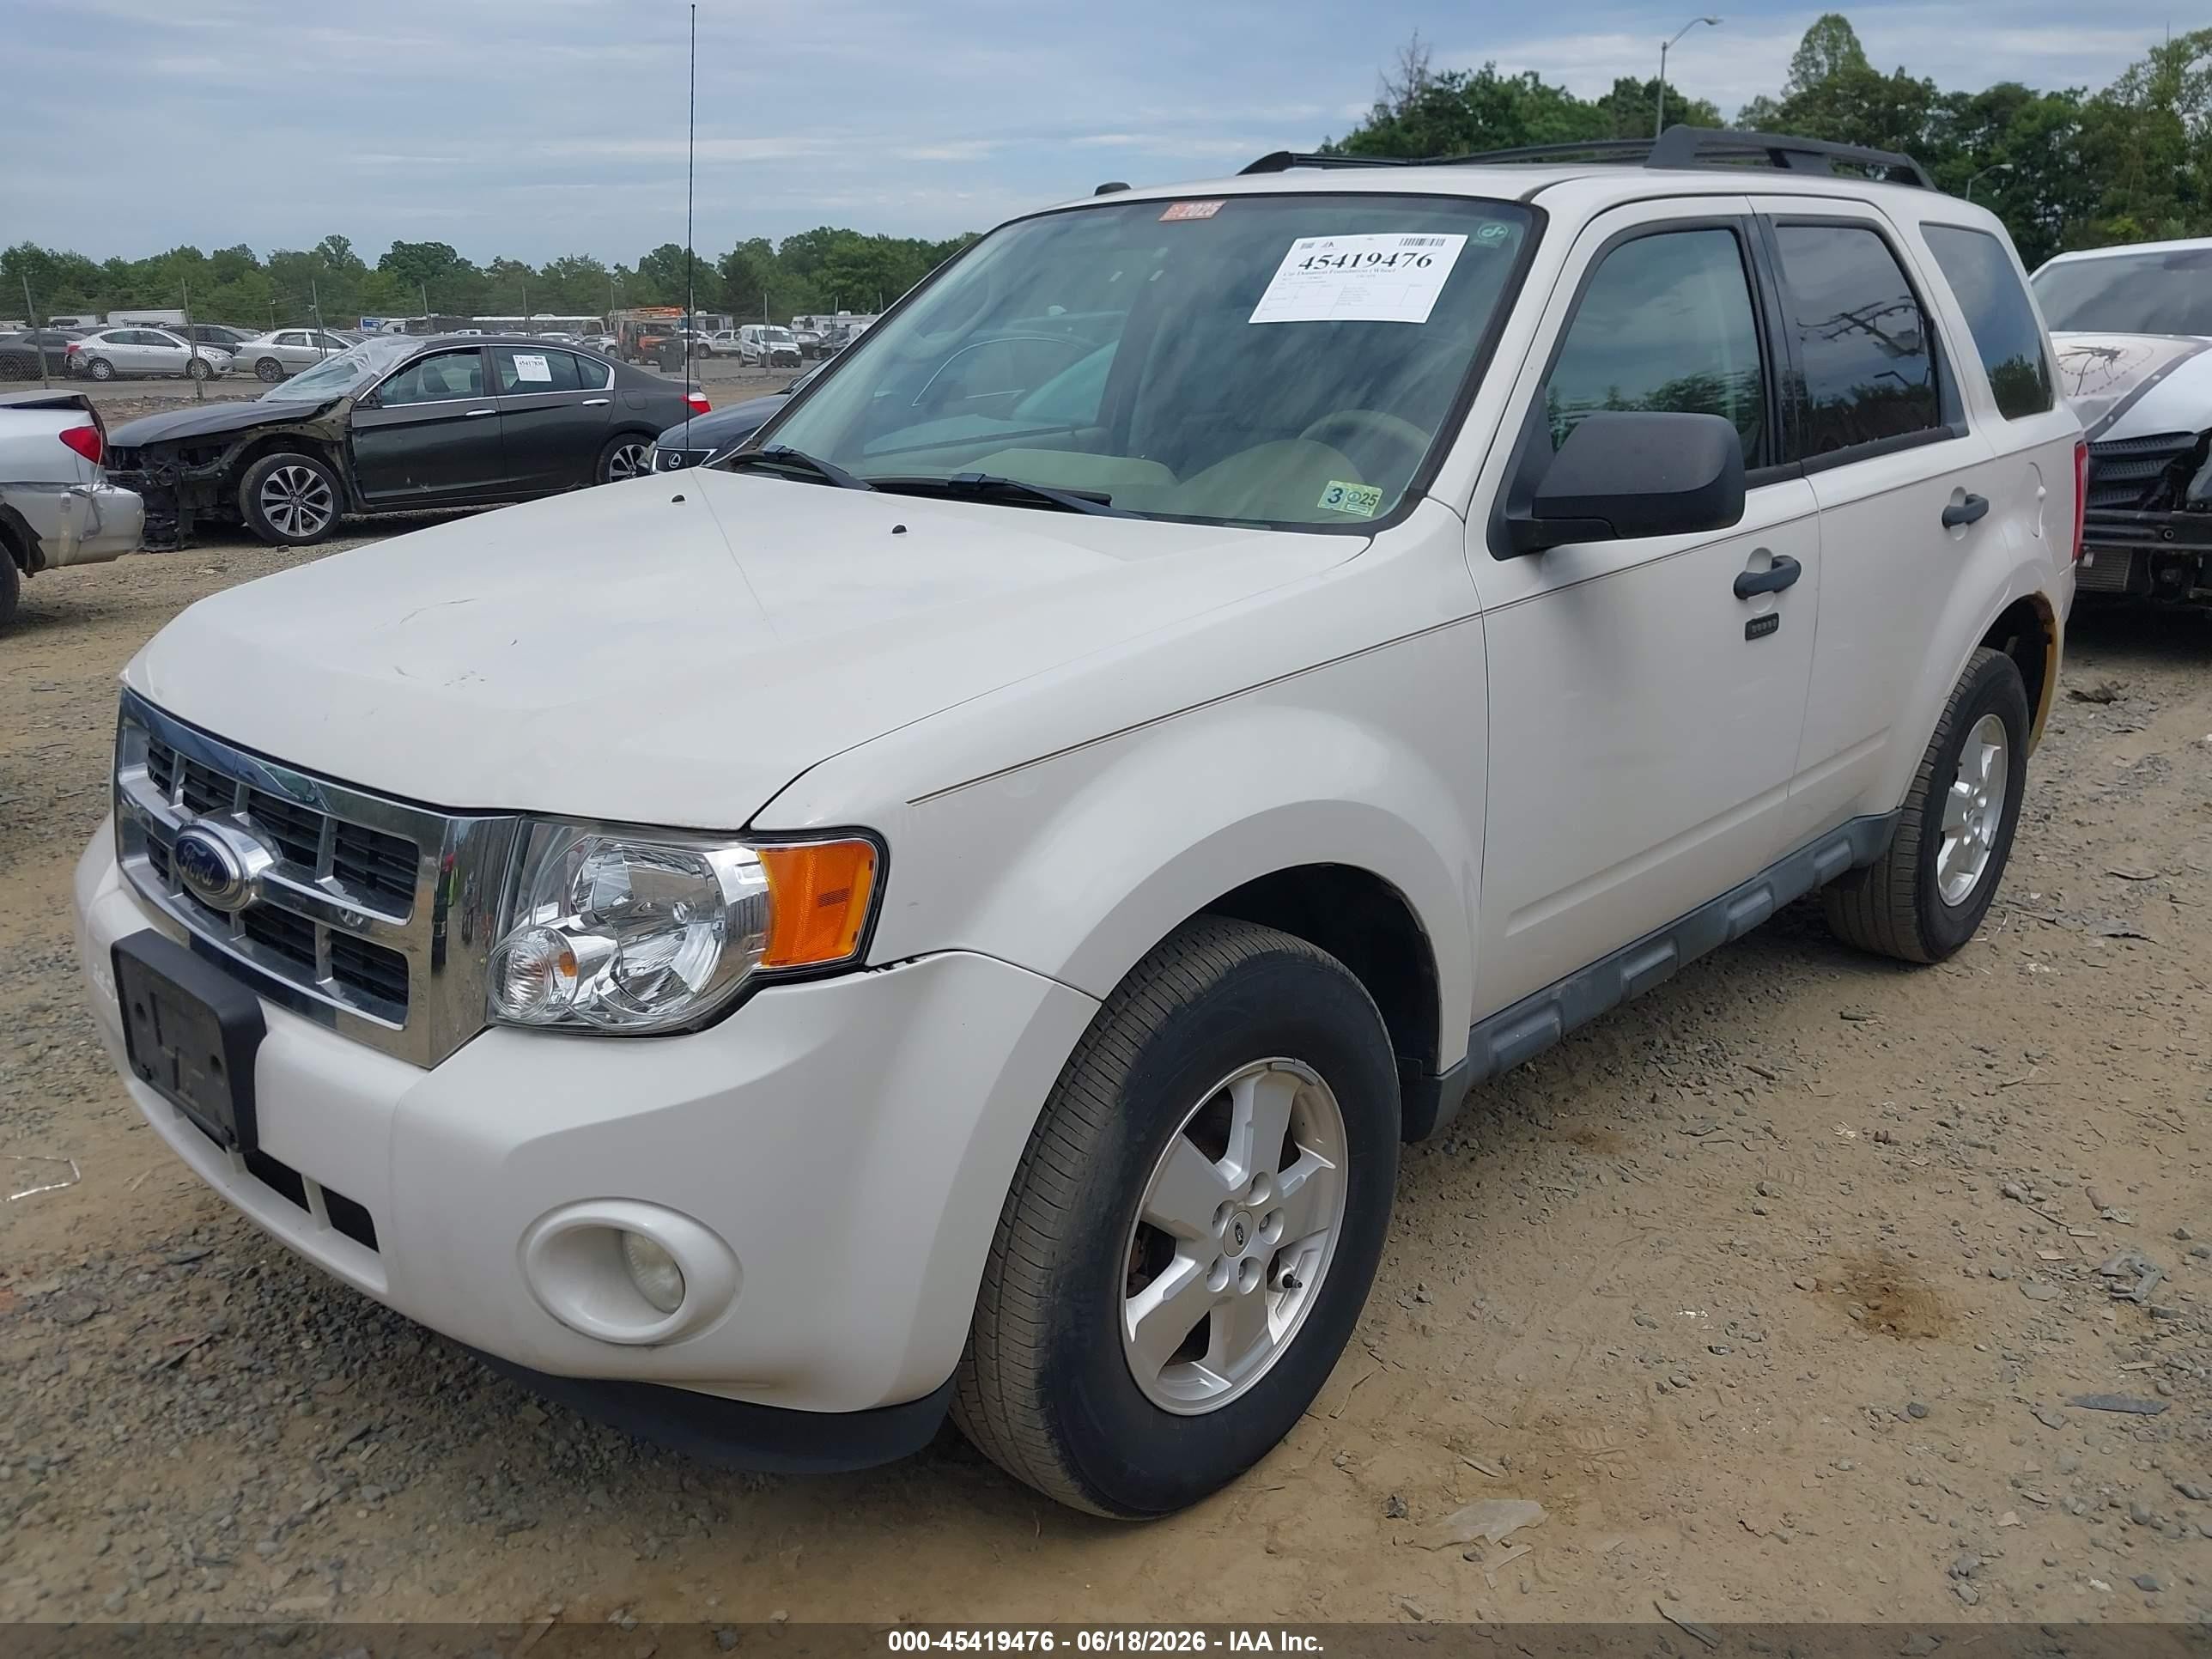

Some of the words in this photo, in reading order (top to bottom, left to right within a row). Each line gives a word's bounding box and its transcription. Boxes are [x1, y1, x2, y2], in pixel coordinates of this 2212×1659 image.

[1298, 252, 1437, 270] 45419476
[1328, 488, 1344, 504] 3
[1359, 492, 1379, 507] 25
